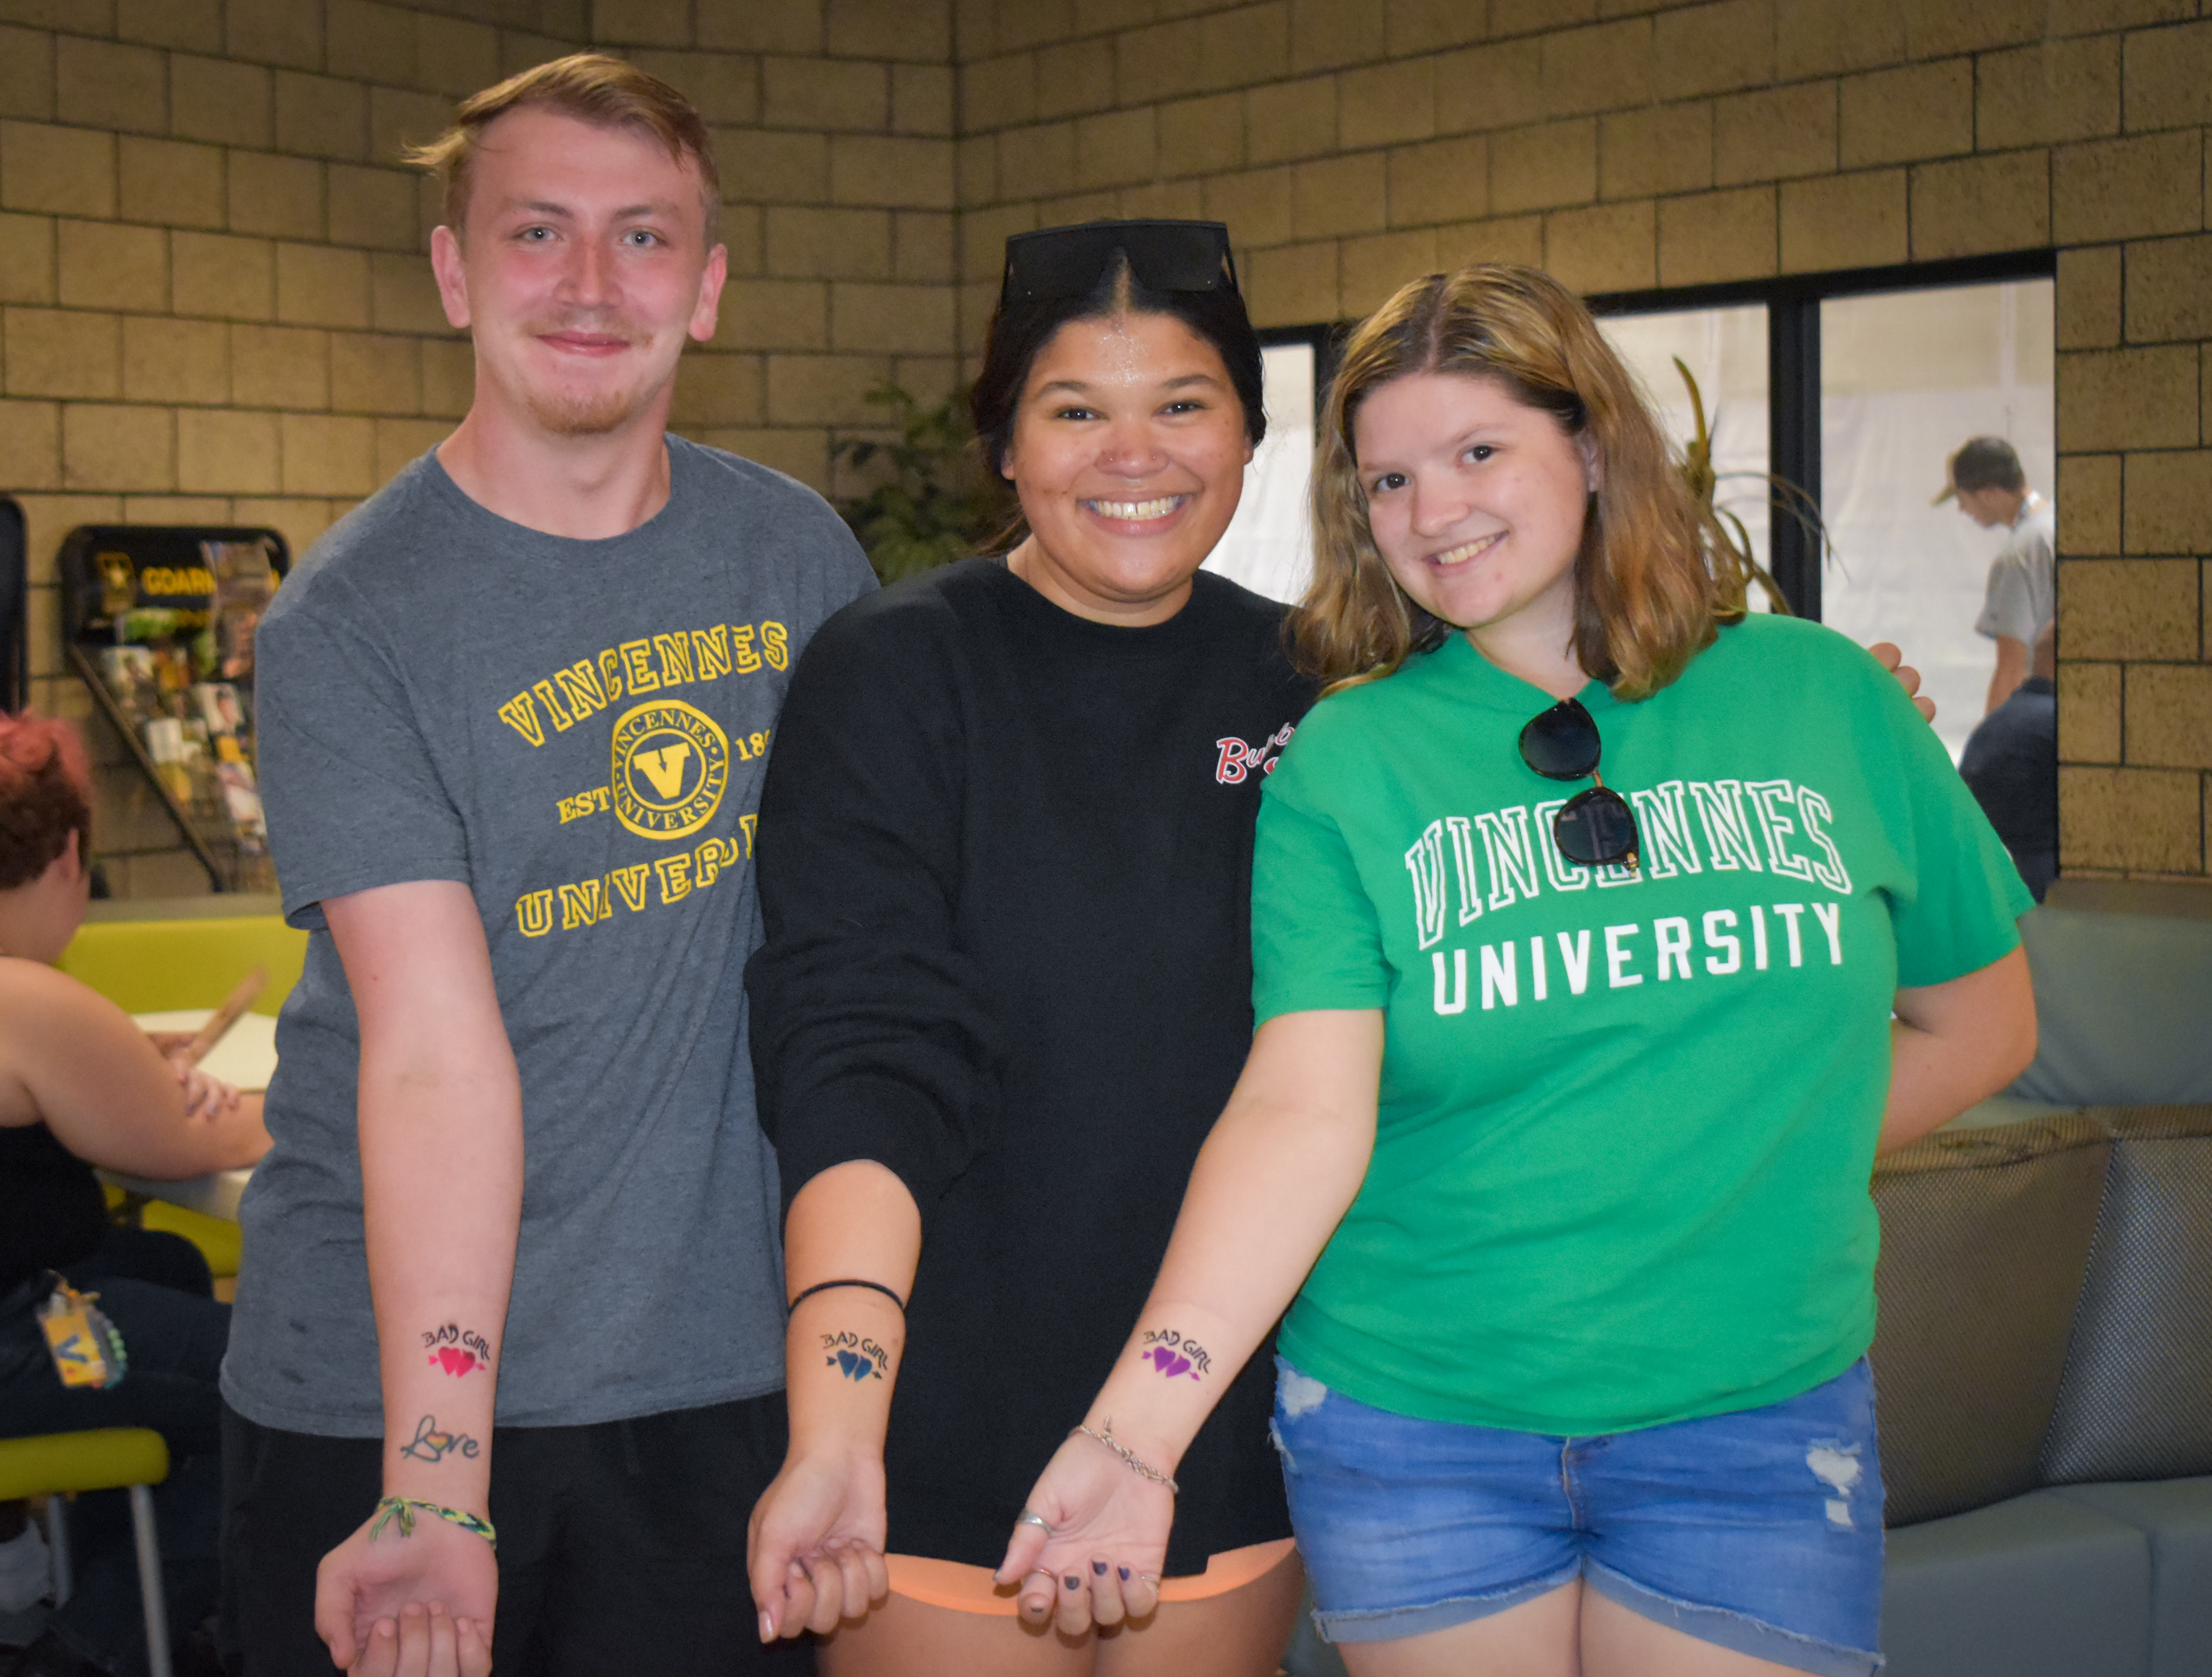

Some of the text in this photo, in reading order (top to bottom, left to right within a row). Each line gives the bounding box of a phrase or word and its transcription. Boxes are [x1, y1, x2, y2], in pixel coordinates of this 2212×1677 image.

[498, 621, 789, 748] VINCENNES
[615, 709, 715, 769] VINCENNES
[616, 758, 725, 830] UNIVERSITY
[633, 742, 691, 799] V
[556, 786, 611, 824] EST
[1432, 903, 1843, 1015] UNIVERSITY
[421, 1322, 490, 1360] BAD GIRL
[820, 1331, 888, 1371] BAD GIRL
[1143, 1328, 1212, 1374] BAD GIRL
